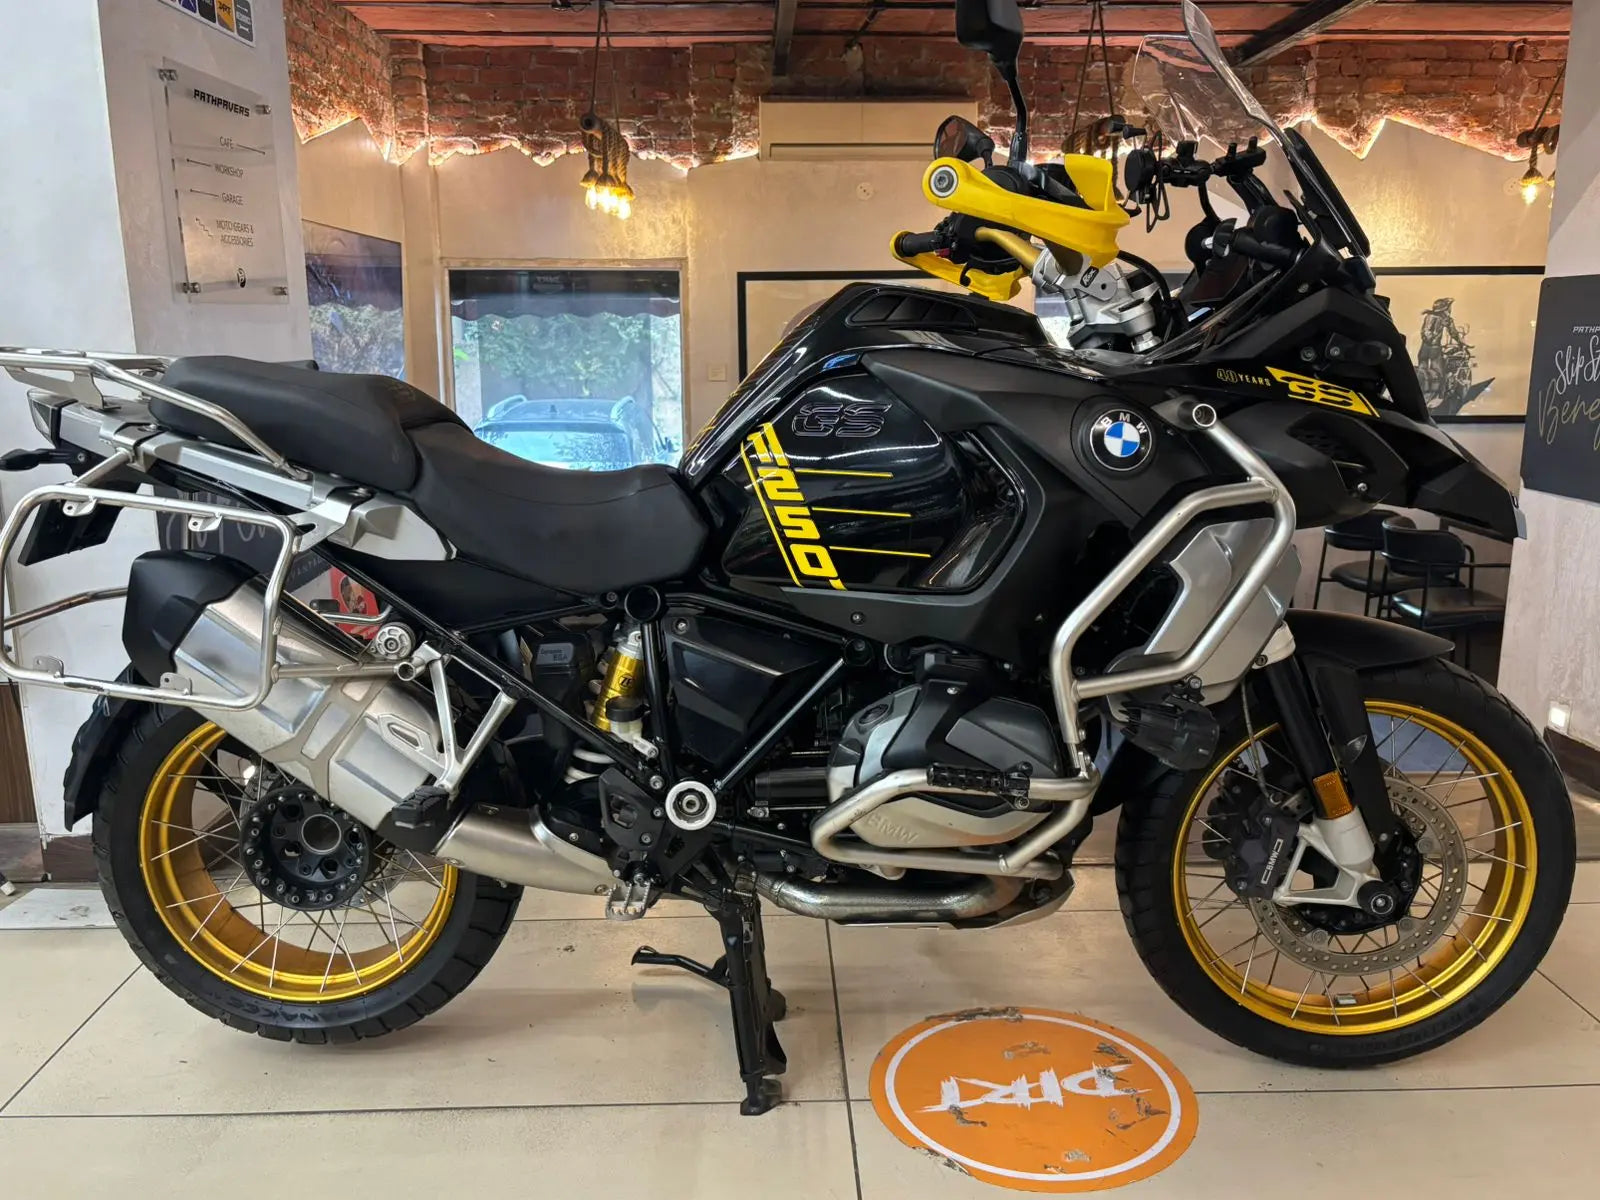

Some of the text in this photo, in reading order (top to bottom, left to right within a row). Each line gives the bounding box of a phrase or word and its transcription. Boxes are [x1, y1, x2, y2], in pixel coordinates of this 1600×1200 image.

[193, 88, 250, 118] PATHPAVERS
[214, 163, 244, 179] WORKSHOP
[221, 192, 244, 206] GARAGE
[1237, 372, 1271, 387] YEARS
[1555, 345, 1585, 395] Slip
[791, 402, 893, 438] GS
[1100, 411, 1148, 435] BMW
[866, 813, 920, 844] BMW
[1265, 850, 1281, 872] BMW
